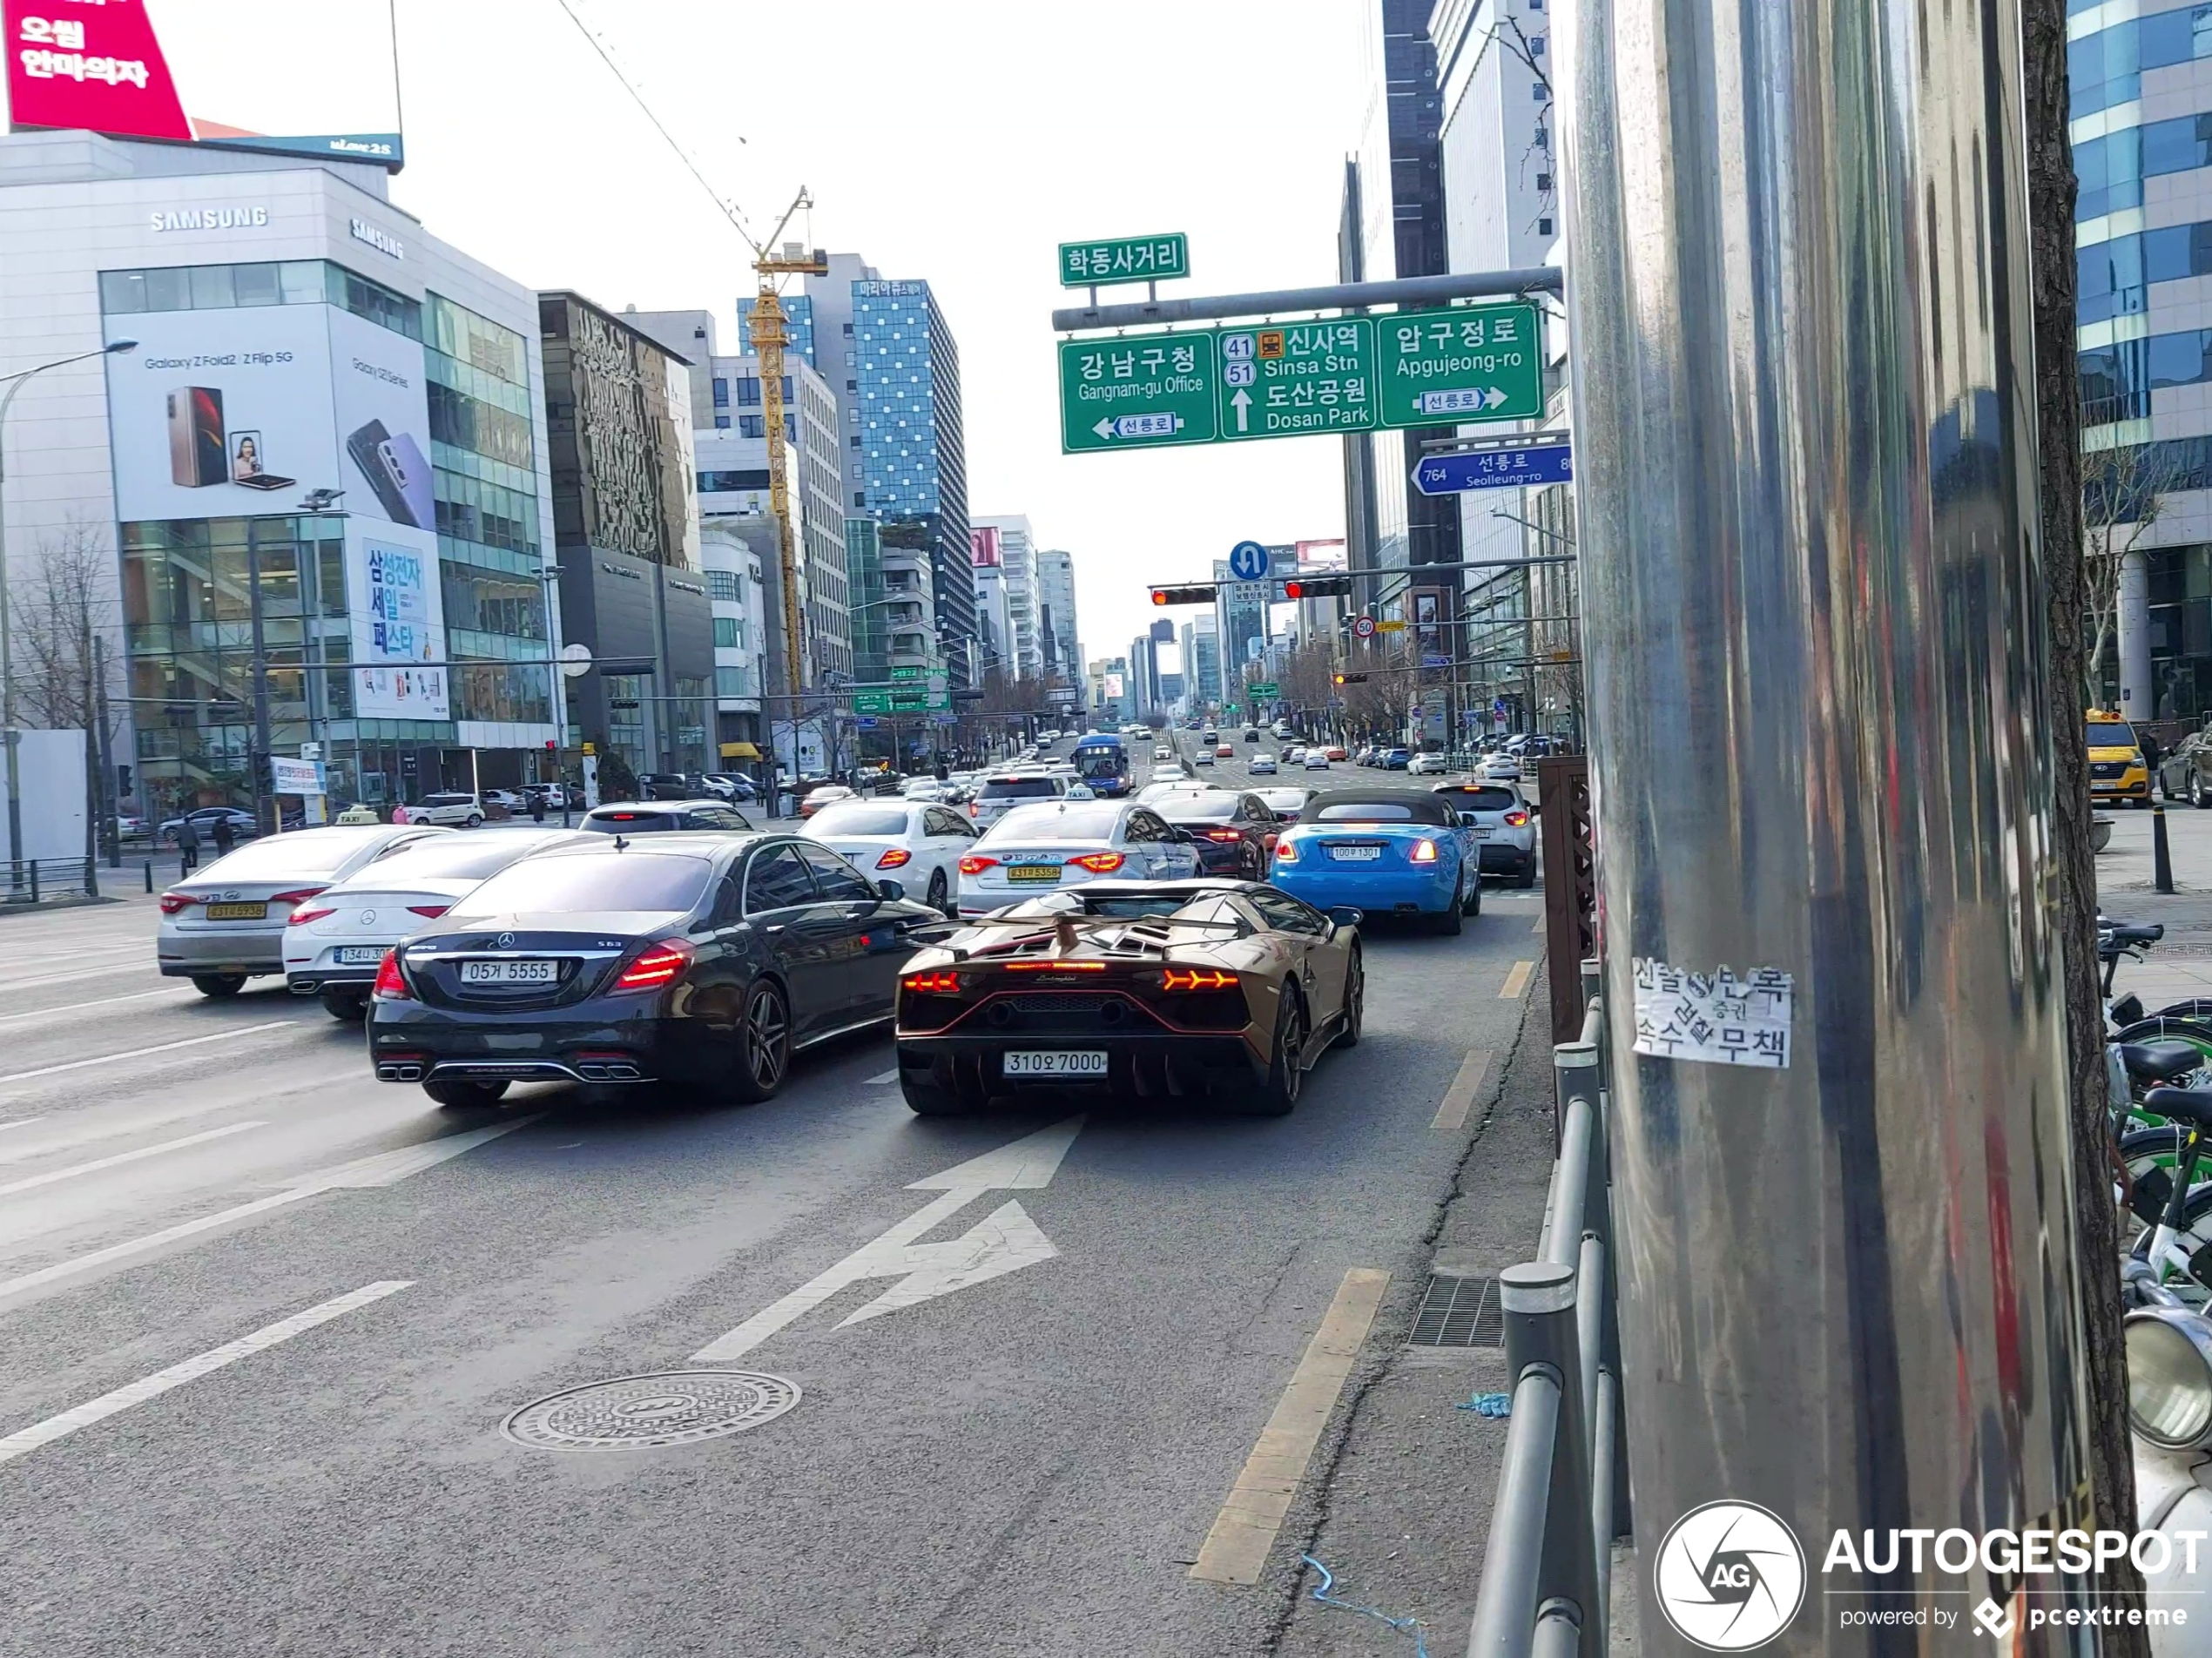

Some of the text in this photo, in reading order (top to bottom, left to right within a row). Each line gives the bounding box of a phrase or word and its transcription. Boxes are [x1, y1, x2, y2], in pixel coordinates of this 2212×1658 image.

[20, 17, 85, 50] 오씸
[20, 50, 149, 89] 안마의자
[151, 206, 268, 233] SAMSUNG
[350, 218, 404, 259] SAMSUNG
[1069, 240, 1177, 276] 학동사거리
[1228, 339, 1250, 356] 41
[1287, 324, 1359, 355] 신사역
[1396, 318, 1518, 354] 압구정로
[145, 352, 293, 370] Galaxy Z Fold2 Z Flip 5G
[353, 357, 377, 381] Galaxy
[1080, 346, 1195, 381] 강남구청
[1264, 356, 1358, 377] Sinsa Stn
[1397, 353, 1521, 380] Apgujeong-ro
[1229, 366, 1251, 382] 51
[1078, 375, 1204, 402] Gangnam-gu Office
[1266, 377, 1366, 408] 도산공원
[1429, 393, 1475, 409] 선릉로
[1124, 417, 1170, 434] 선릉로
[1267, 407, 1369, 430] Dosan Park
[1424, 468, 1447, 482] 764
[1479, 454, 1528, 473] 선릉로
[1467, 472, 1541, 487] Seolleung-ro
[369, 549, 421, 590] 삼성전자
[372, 587, 398, 621] 세일
[1359, 623, 1372, 632] 50
[374, 623, 414, 657] 페스타
[1359, 848, 1378, 857] 1301
[1035, 868, 1057, 877] 5358
[237, 906, 261, 916] 5938
[470, 963, 549, 980] 05거 5555
[1010, 1054, 1101, 1070] 310오 7000
